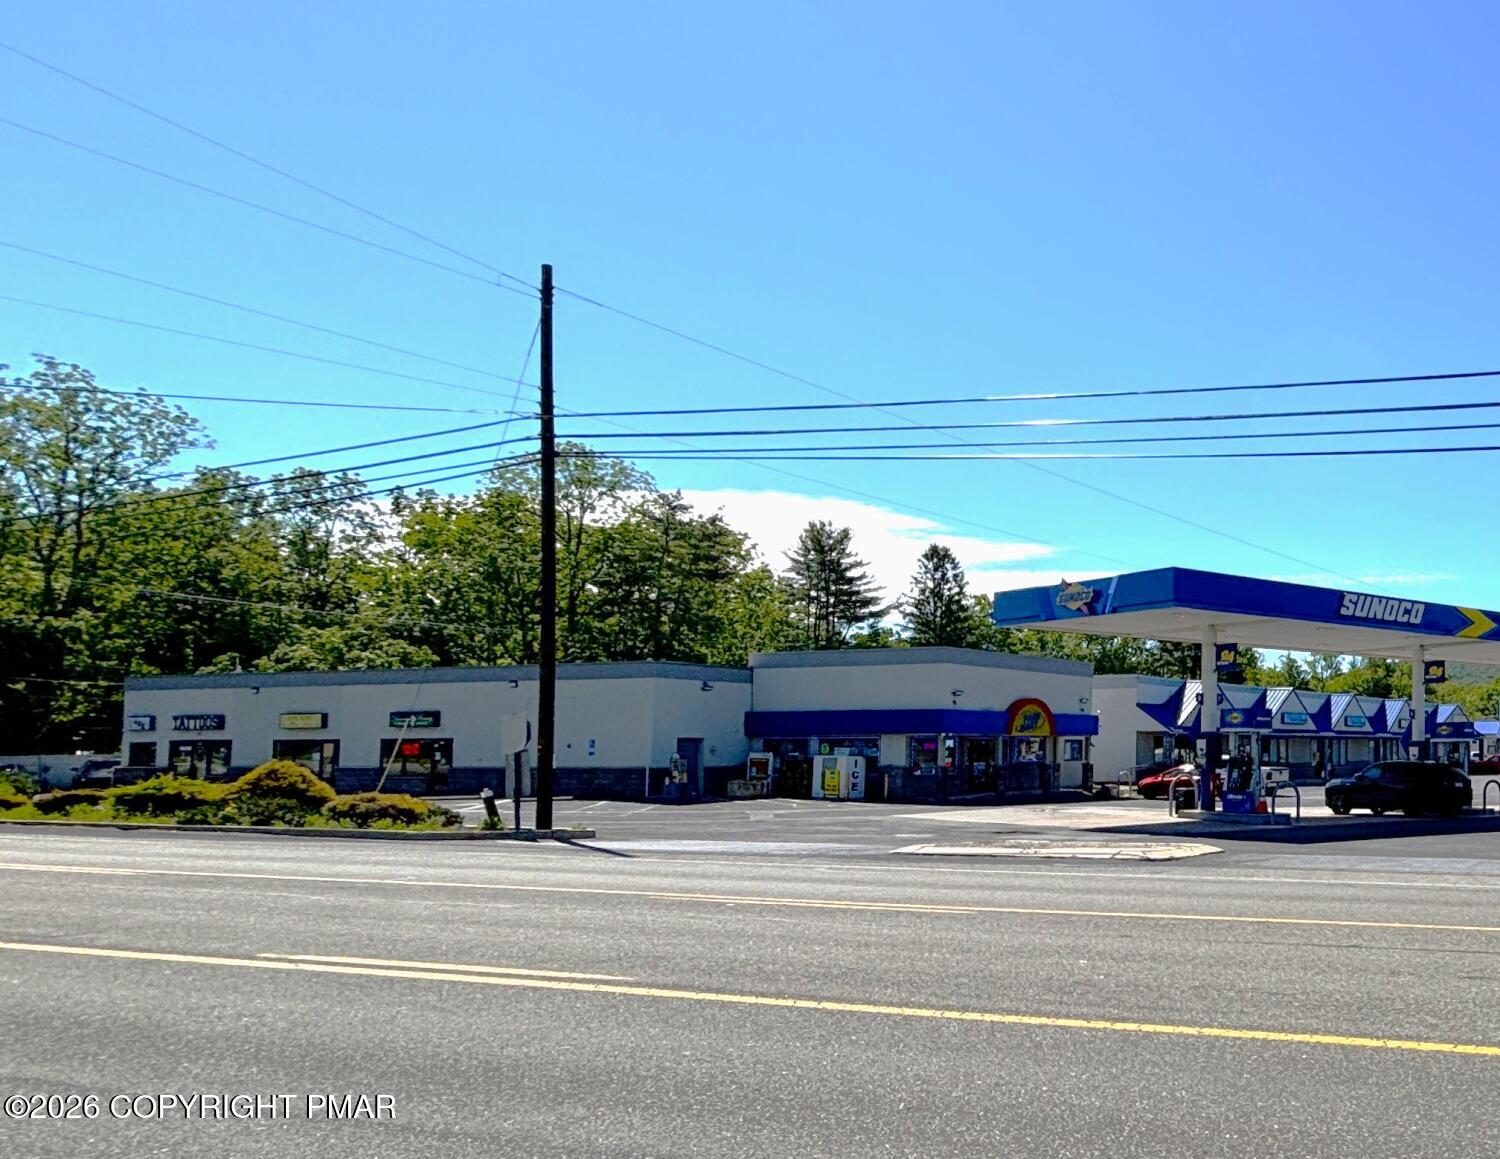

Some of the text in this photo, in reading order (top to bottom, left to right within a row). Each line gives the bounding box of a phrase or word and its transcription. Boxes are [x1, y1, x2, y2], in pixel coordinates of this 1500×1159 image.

[1058, 590, 1092, 603] SUNOCO
[1340, 592, 1425, 624] SUNOCO
[851, 759, 860, 792] ICE
